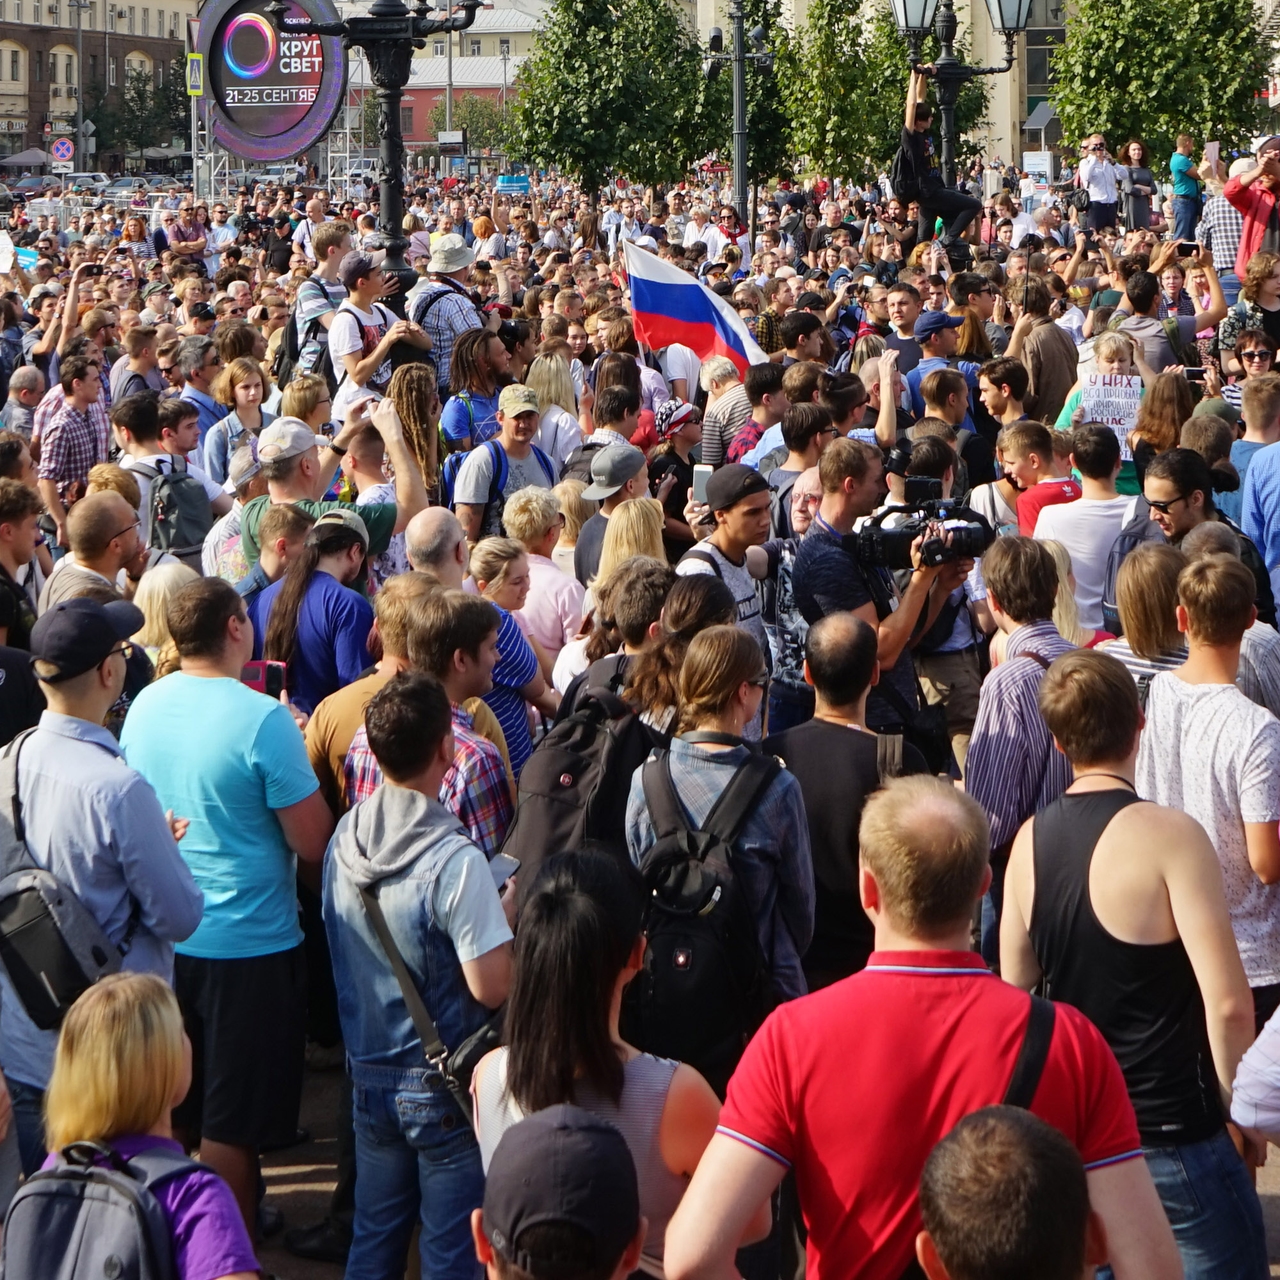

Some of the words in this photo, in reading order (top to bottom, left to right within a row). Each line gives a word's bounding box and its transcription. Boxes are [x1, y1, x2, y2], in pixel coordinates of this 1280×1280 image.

[280, 40, 321, 56] КРУГ
[280, 58, 322, 73] СВЕТ
[226, 89, 260, 103] 21-25
[263, 89, 320, 103] СЕНТЯБ
[1089, 374, 1098, 386] У
[1083, 388, 1100, 398] ВСЯ
[1104, 389, 1140, 400] ПРИБЫЛЬ
